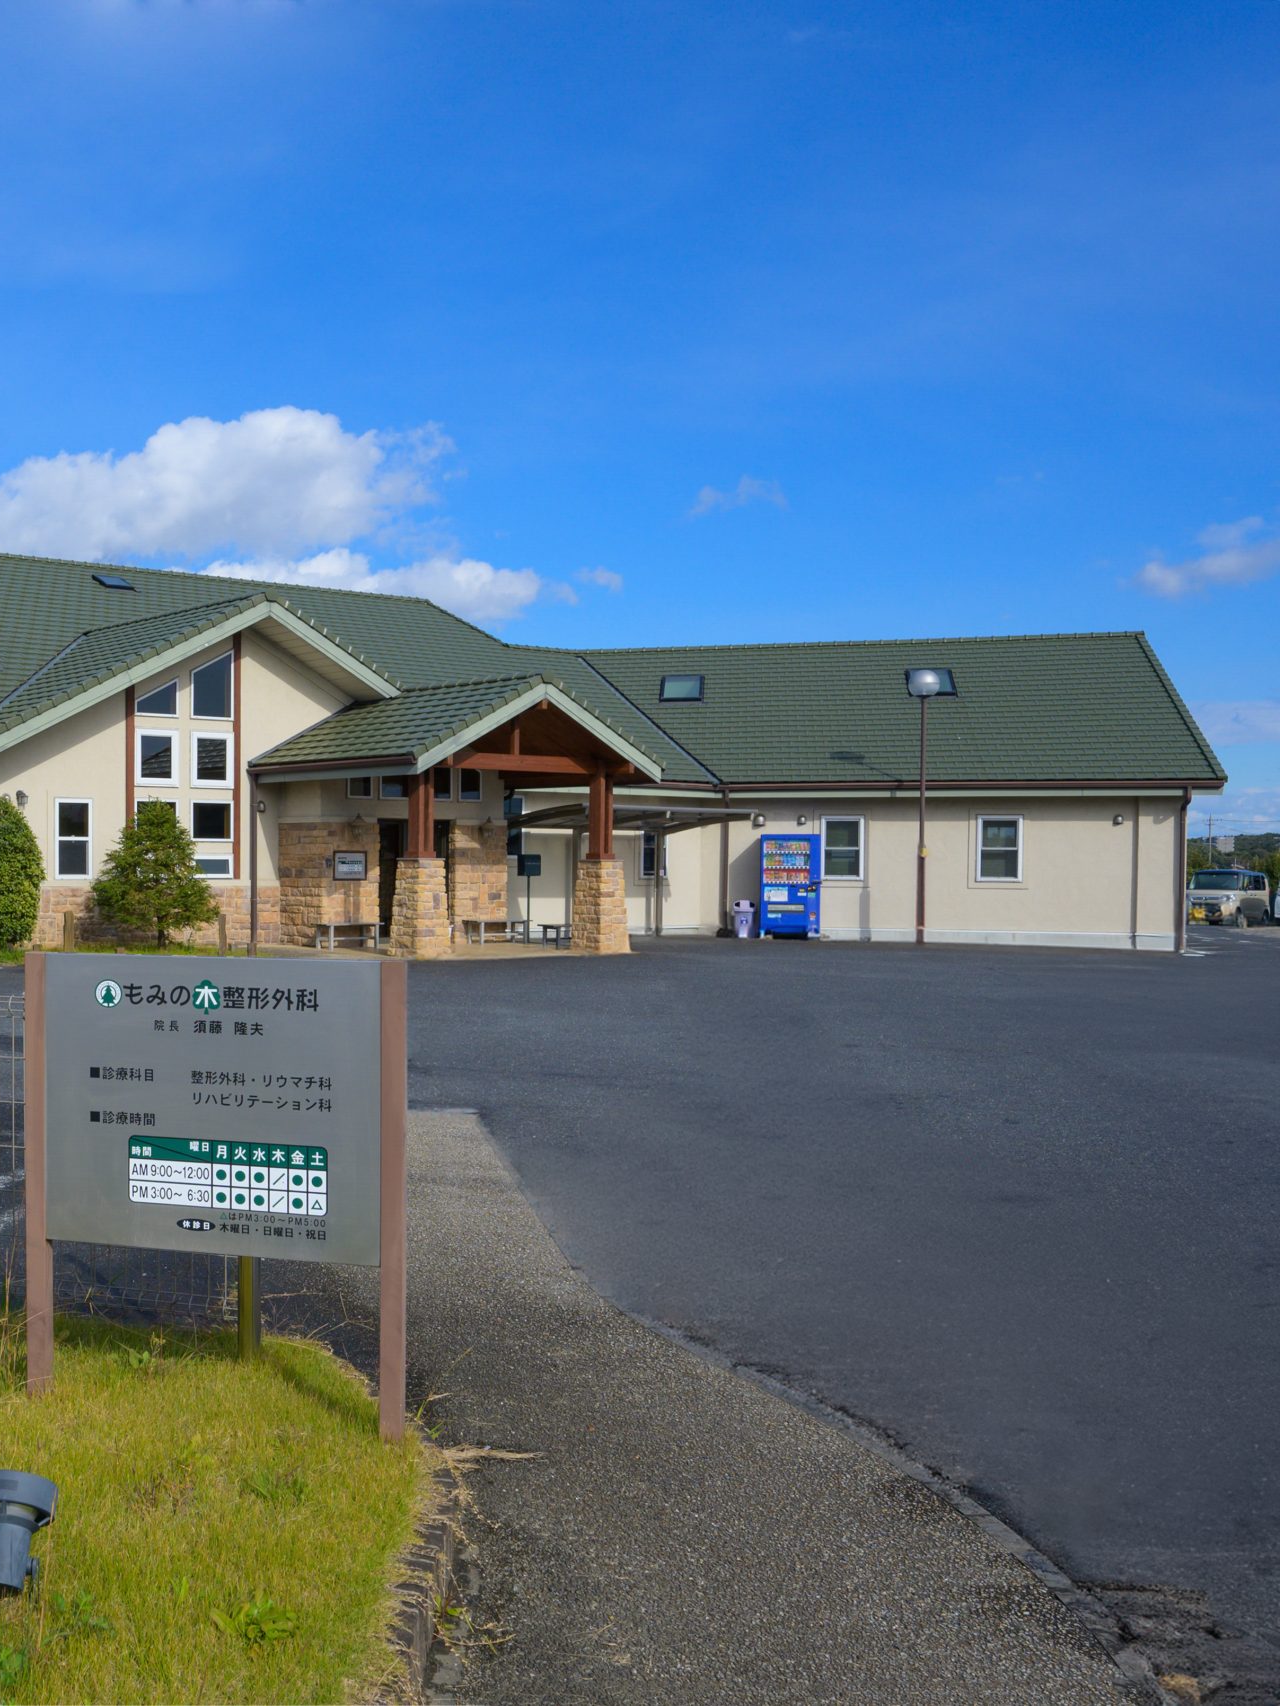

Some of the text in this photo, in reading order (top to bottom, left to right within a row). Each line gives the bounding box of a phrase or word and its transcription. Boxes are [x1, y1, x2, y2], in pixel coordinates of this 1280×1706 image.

[122, 979, 320, 1014] もみの木整形外科
[153, 1020, 265, 1036] 院長 須藤 隆夫
[102, 1066, 155, 1082] 診療科目
[190, 1070, 332, 1091] 整形外科・リウマチ科
[191, 1092, 332, 1113] リハビリテーション科
[102, 1111, 156, 1127] 診療時間
[131, 1146, 152, 1158] 時間
[189, 1141, 324, 1166] 曜日 月 火 水 木 金 土
[131, 1163, 149, 1176] AM
[131, 1185, 149, 1198] PM
[187, 1189, 210, 1203] 6:30
[182, 1220, 210, 1231] 休診日
